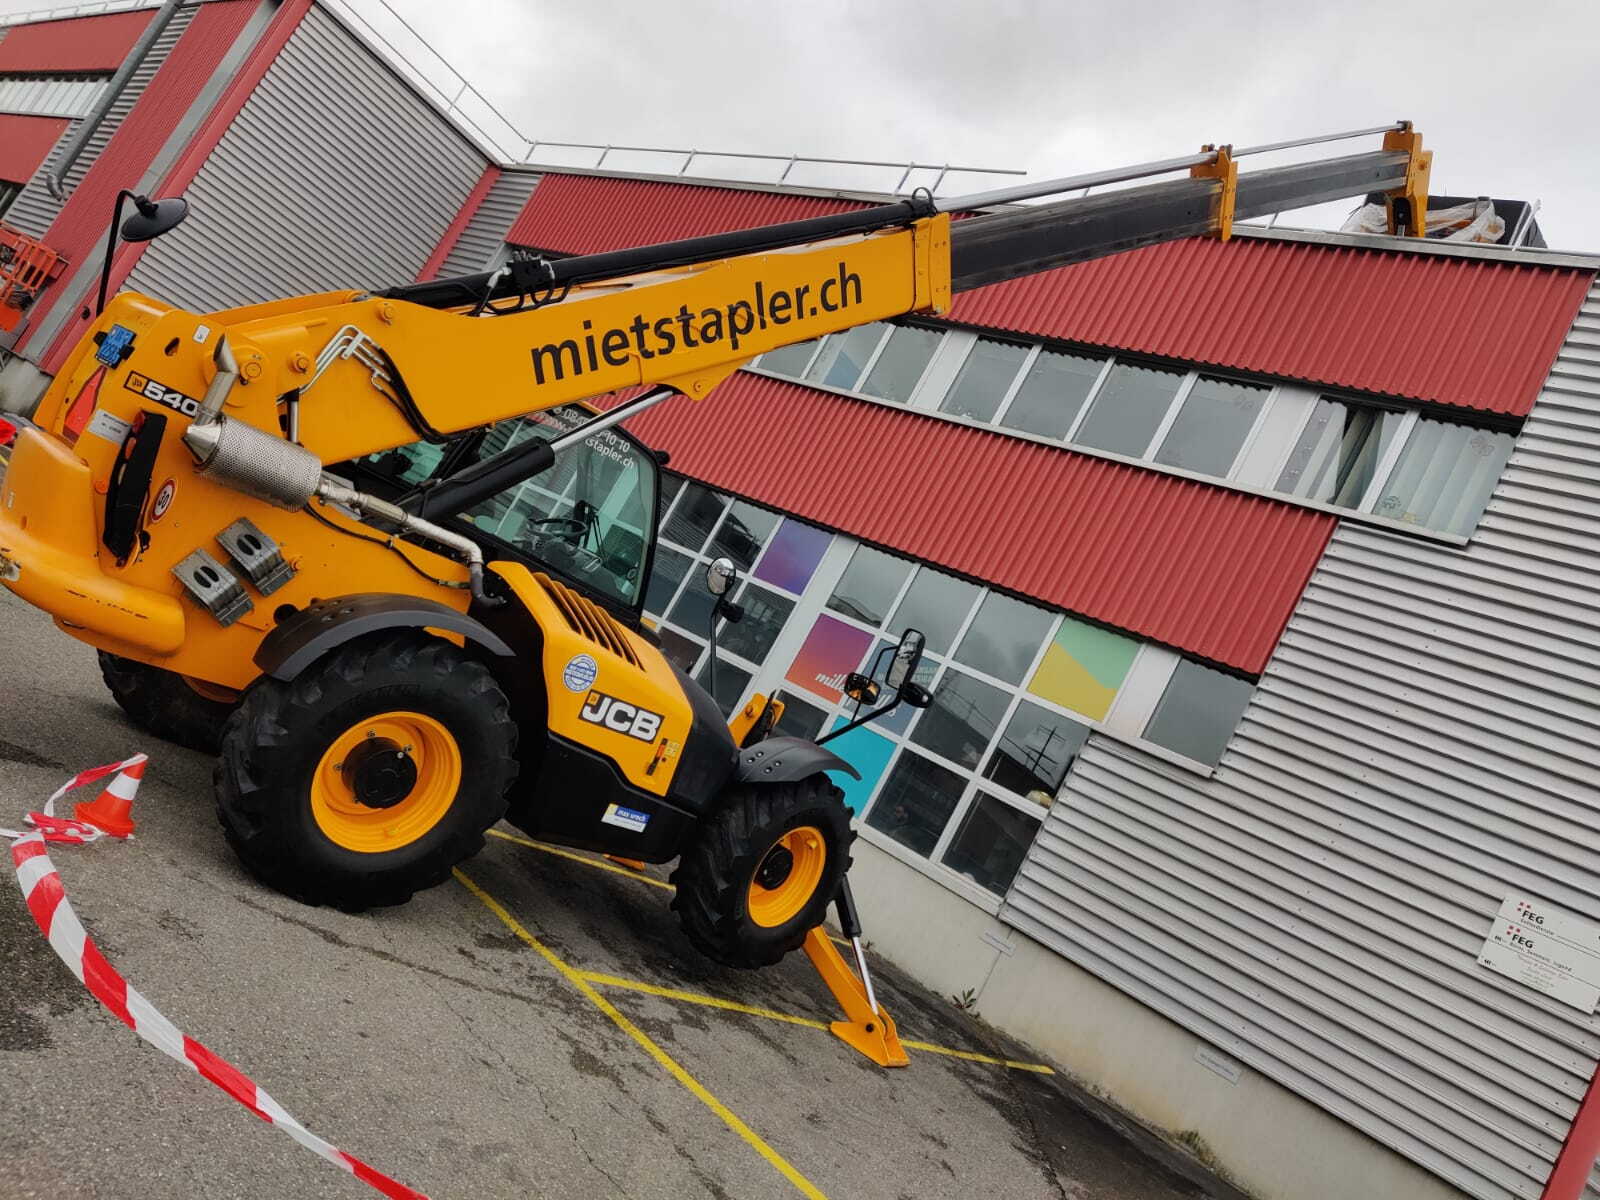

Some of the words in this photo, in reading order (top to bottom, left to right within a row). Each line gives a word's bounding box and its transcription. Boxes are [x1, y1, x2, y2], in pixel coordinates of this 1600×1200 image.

[530, 262, 863, 385] mietstapler.ch
[143, 379, 201, 418] 540
[618, 440, 631, 453] 10
[582, 697, 661, 741] JCB
[1521, 910, 1545, 925] FEG
[1511, 934, 1534, 948] FEG
